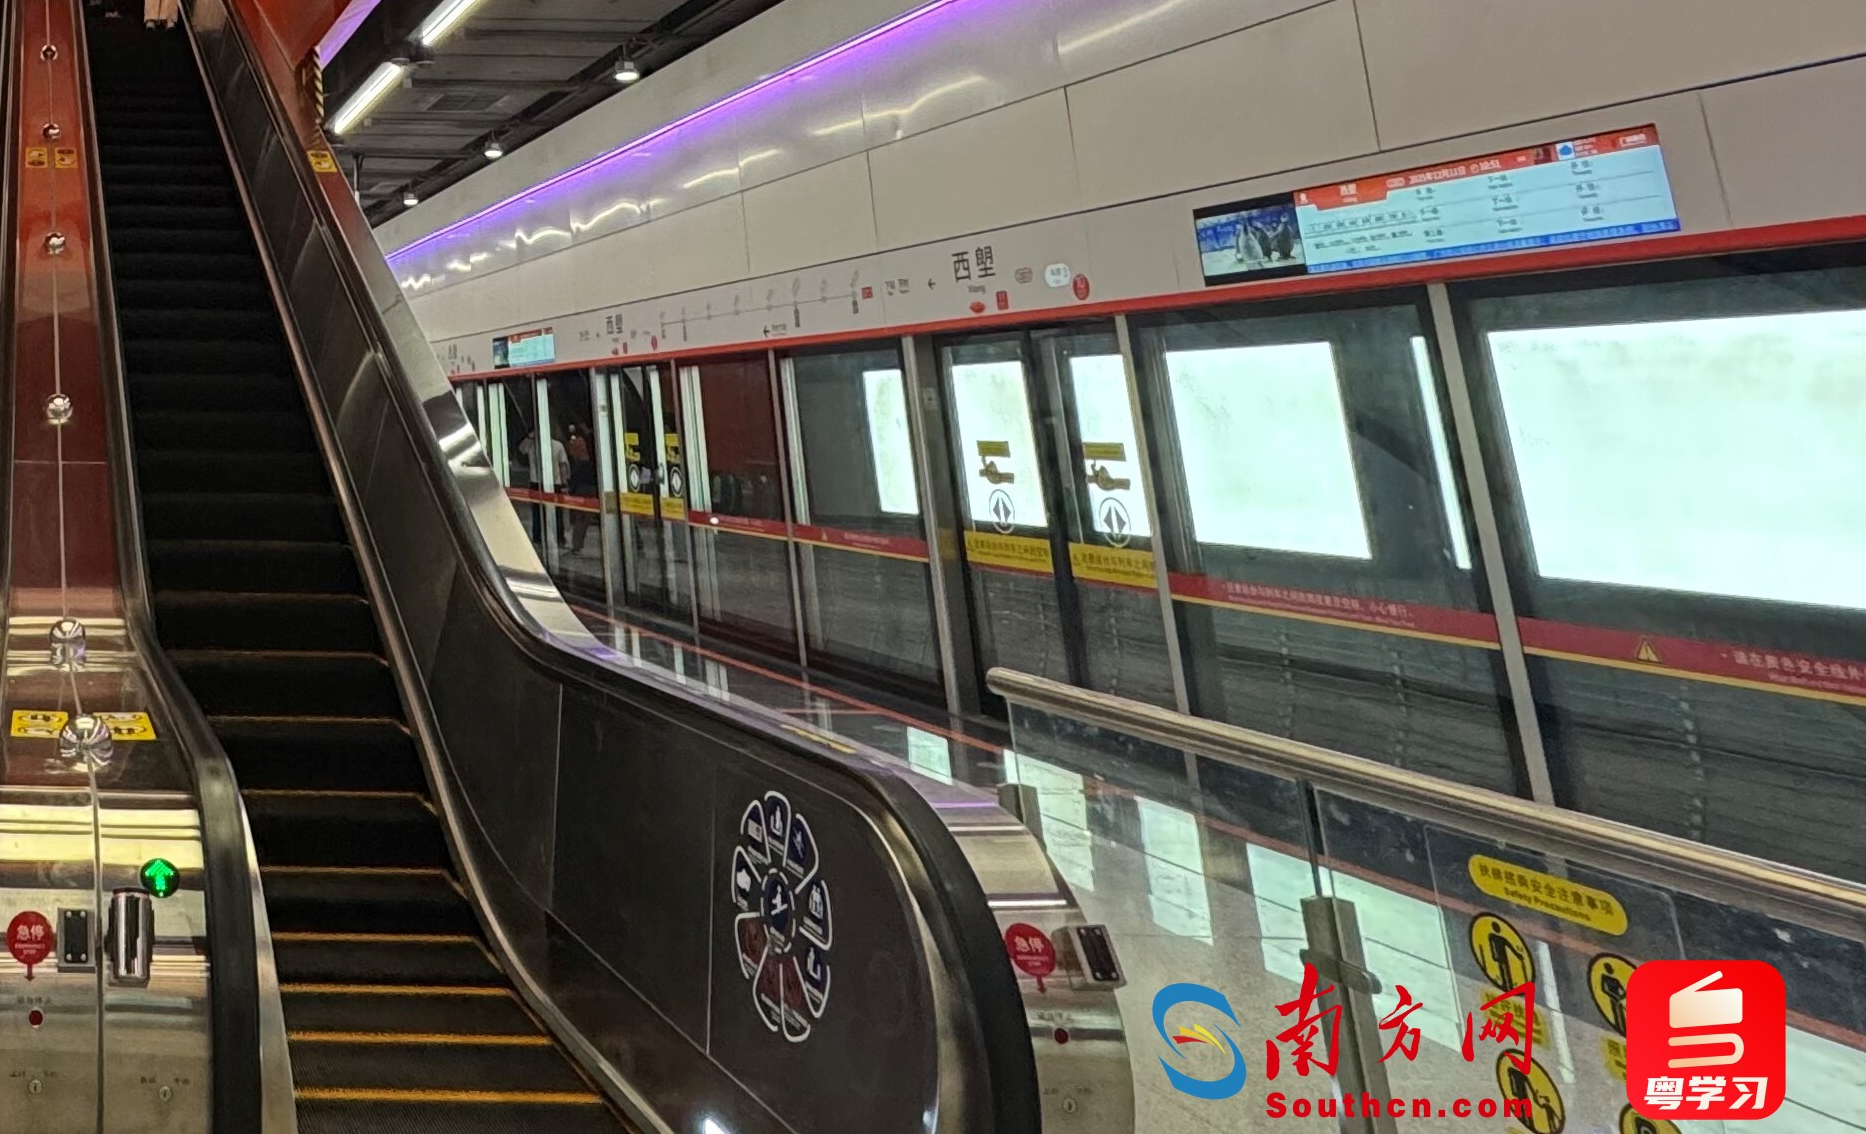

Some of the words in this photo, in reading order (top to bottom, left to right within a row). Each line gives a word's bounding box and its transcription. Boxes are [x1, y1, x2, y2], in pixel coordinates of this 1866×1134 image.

[951, 245, 996, 282] 西塱
[16, 924, 45, 941] 急停
[1014, 935, 1044, 954] 急停
